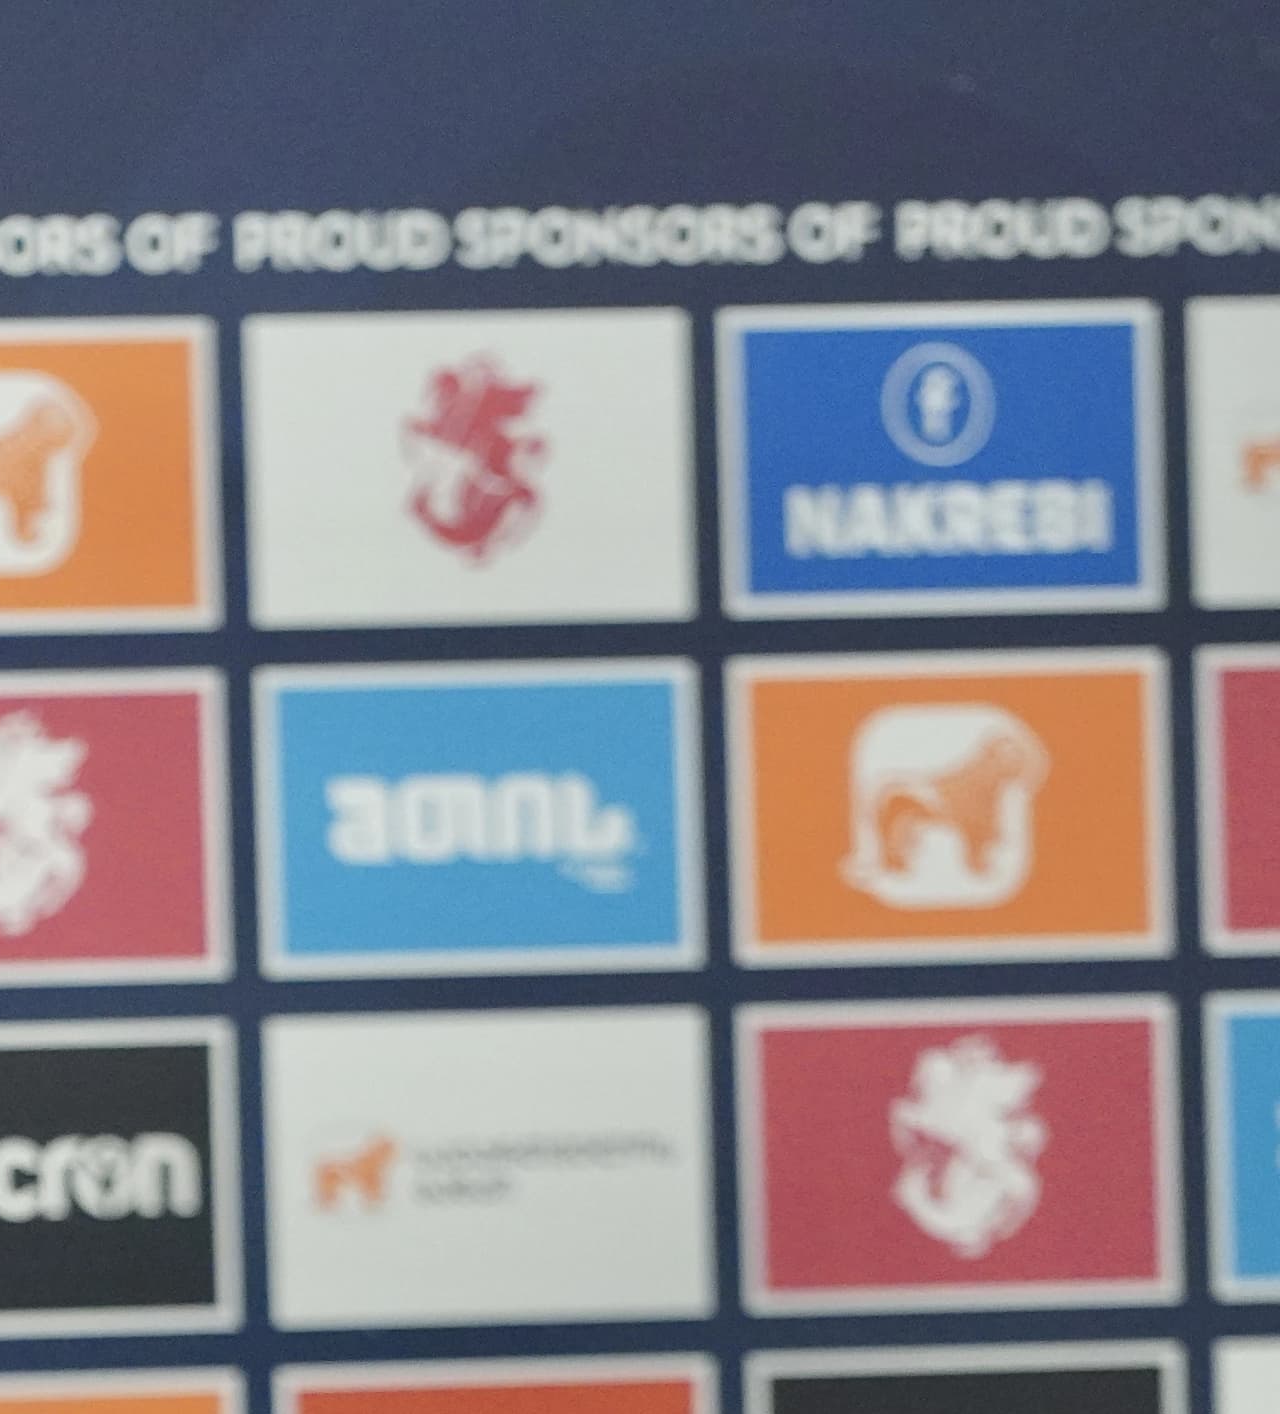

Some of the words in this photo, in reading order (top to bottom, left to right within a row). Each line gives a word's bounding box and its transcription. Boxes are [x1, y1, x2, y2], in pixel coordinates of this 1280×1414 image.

[125, 213, 217, 274] OF
[234, 209, 451, 271] PROUD
[451, 204, 784, 268] SPONSORS
[786, 202, 878, 262] OF
[895, 198, 1110, 259] PROUD
[786, 480, 1111, 556] NAKREBI
